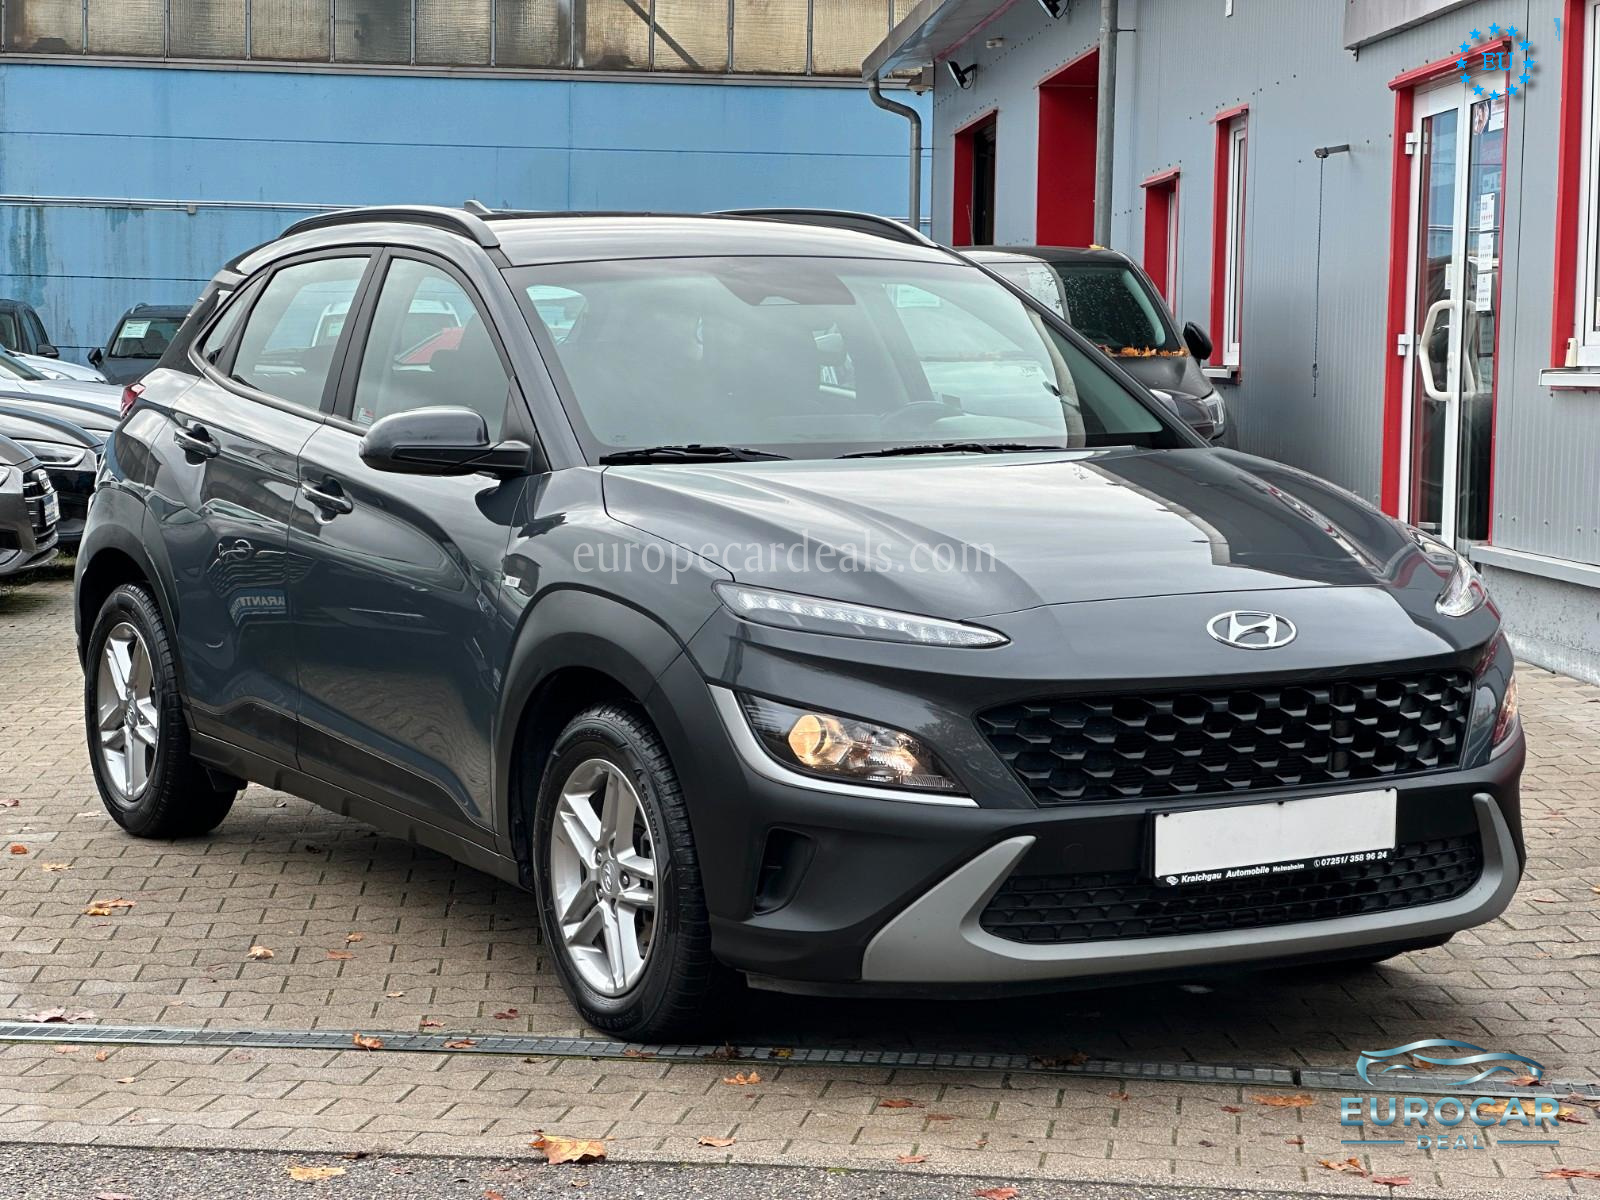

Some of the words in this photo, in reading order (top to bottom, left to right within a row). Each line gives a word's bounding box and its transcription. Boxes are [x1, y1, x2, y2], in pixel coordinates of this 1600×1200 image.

[1181, 873, 1222, 883] Kraichgau
[1226, 865, 1270, 878] Automobile
[1321, 855, 1348, 866] 07251/
[1349, 853, 1364, 863] 358
[1377, 851, 1388, 859] 24
